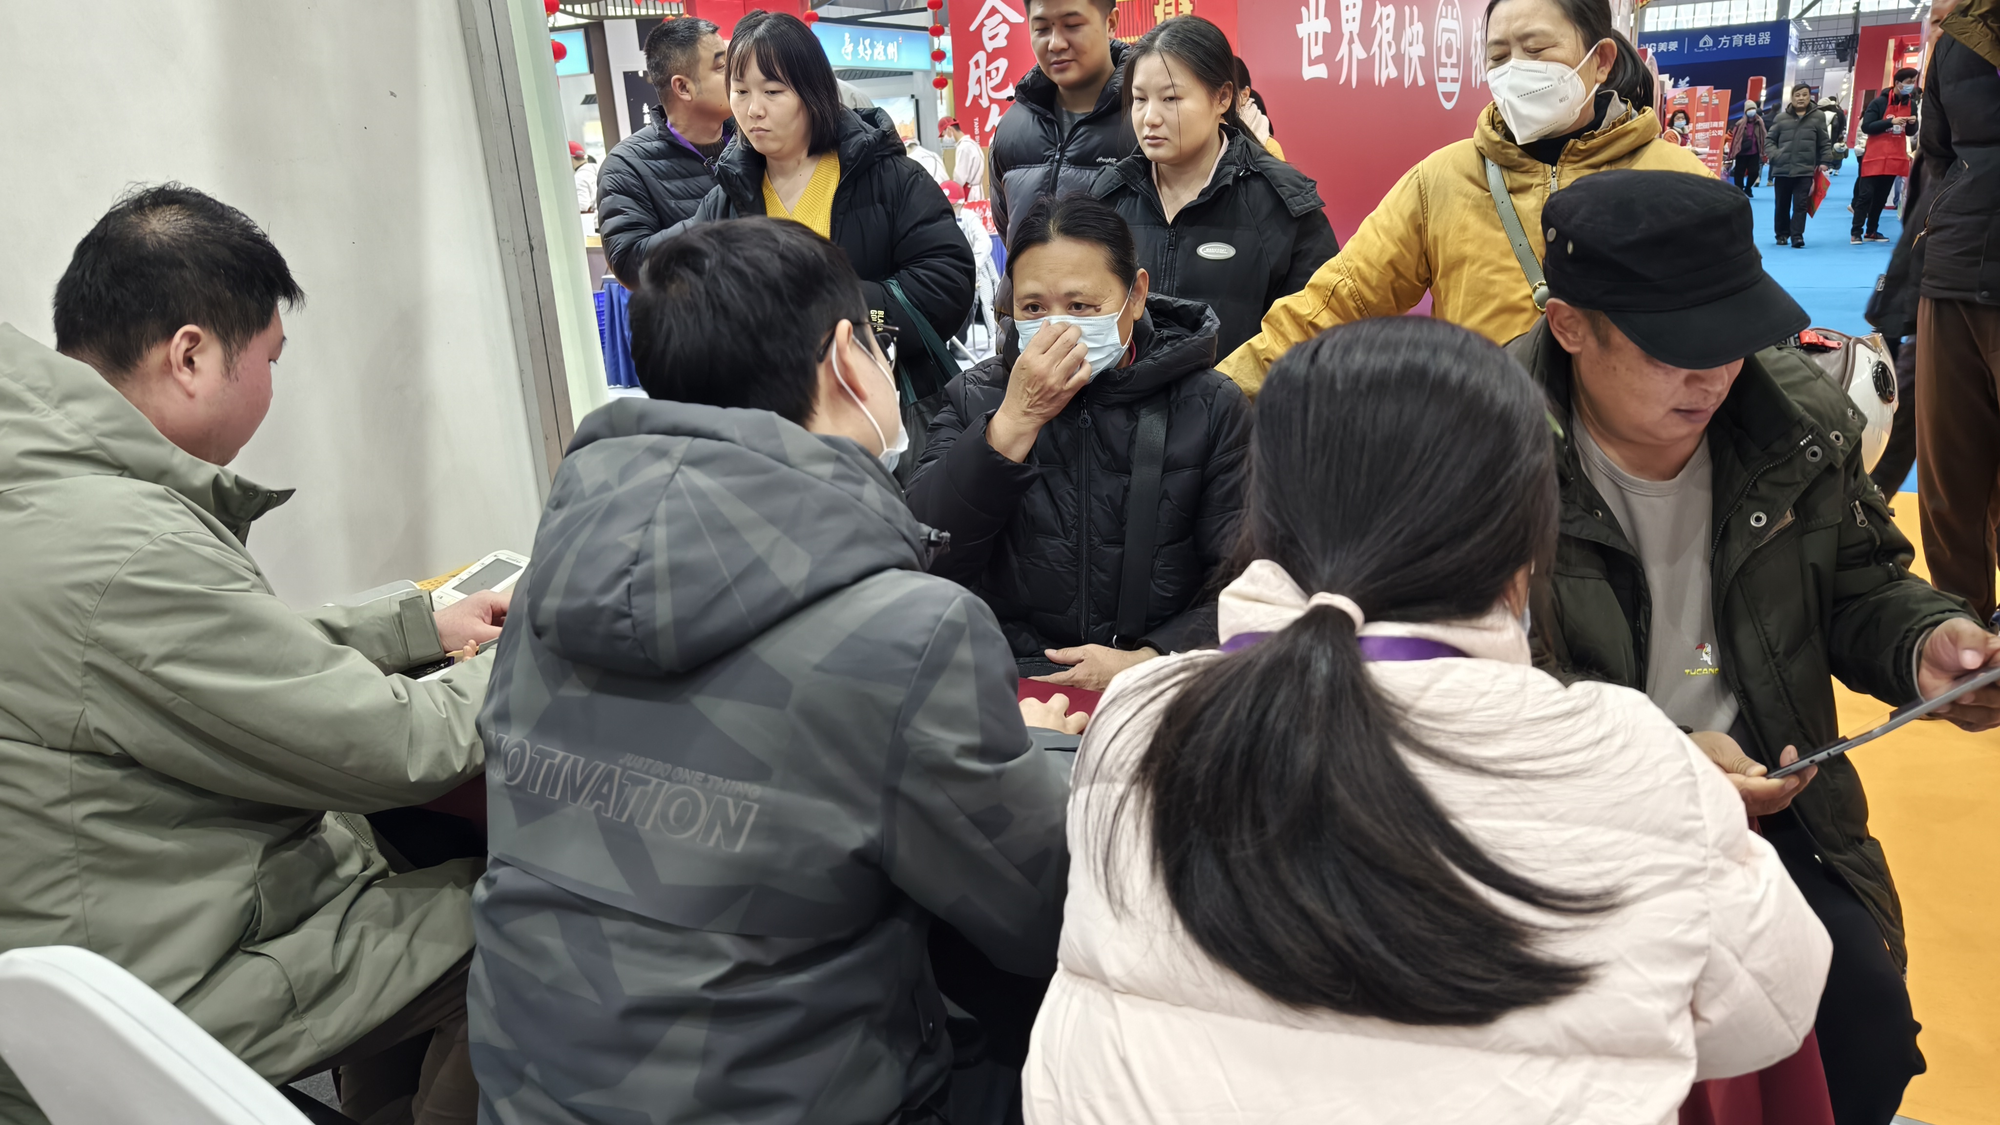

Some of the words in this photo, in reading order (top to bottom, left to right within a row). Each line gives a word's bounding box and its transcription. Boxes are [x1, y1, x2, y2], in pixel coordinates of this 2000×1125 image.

[965, 0, 1025, 133] 合肥
[1296, 0, 1426, 89] 世界很快
[1718, 31, 1771, 49] 方育电器
[618, 753, 655, 771] JUST
[650, 760, 672, 777] DO
[671, 766, 706, 786] ONE
[706, 775, 761, 799] THING
